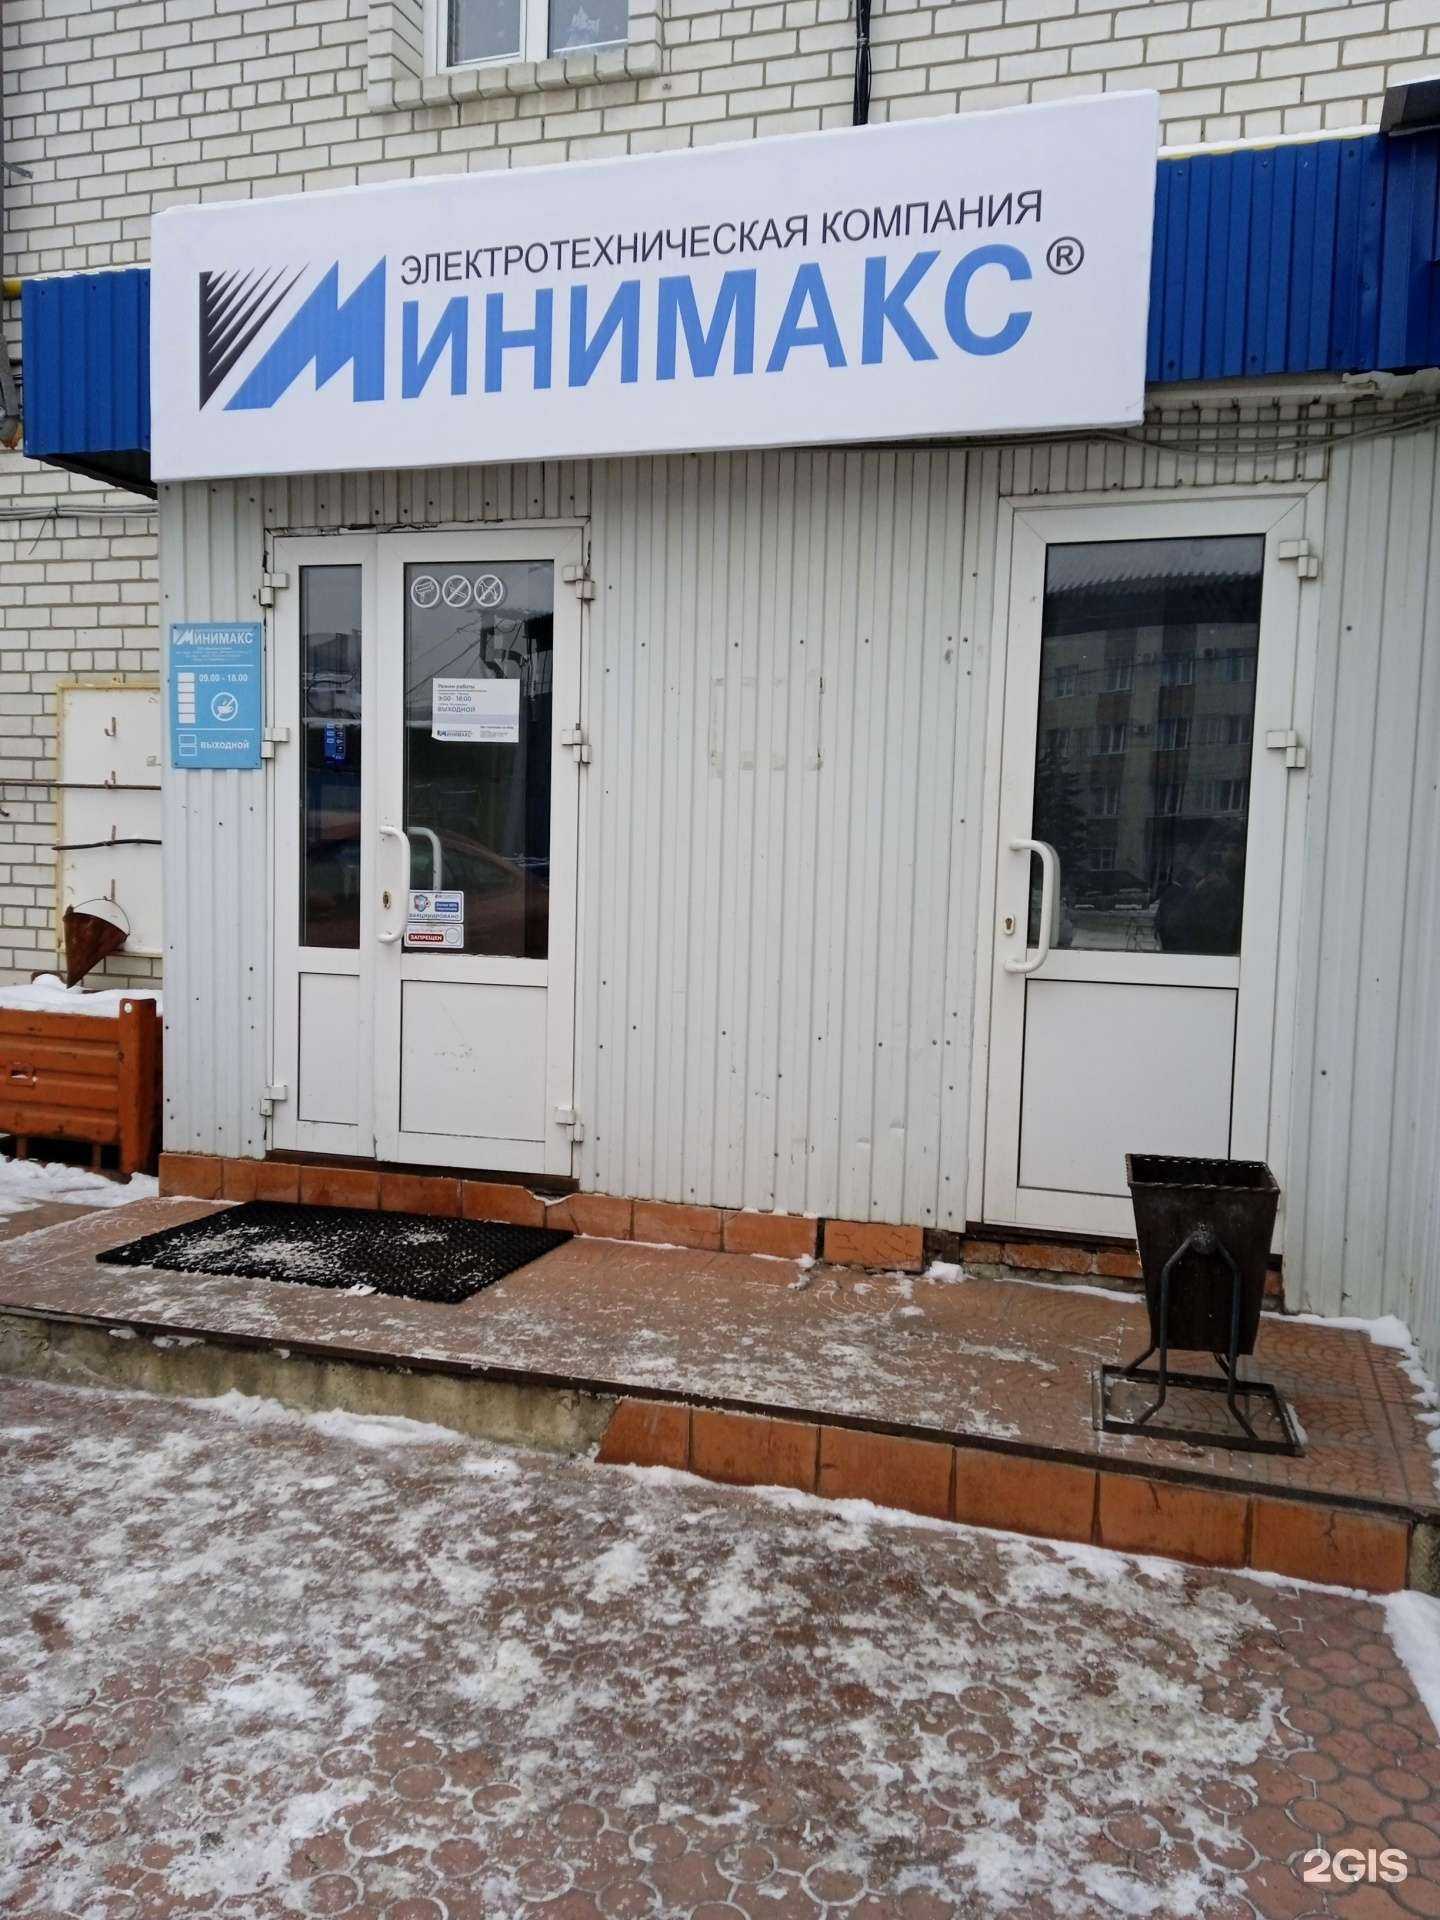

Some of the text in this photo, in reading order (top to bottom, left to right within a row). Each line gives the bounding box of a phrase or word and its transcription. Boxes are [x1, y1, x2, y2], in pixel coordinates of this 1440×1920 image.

[400, 189, 1043, 286] ЭЛЕКТРОТЕХНИЧЕСКАЯ КОМПАНИЯ
[221, 243, 1033, 412] МИНИМАКС
[176, 629, 254, 646] МИНИМАКС
[200, 739, 250, 749] ВЫХОДНОЙ
